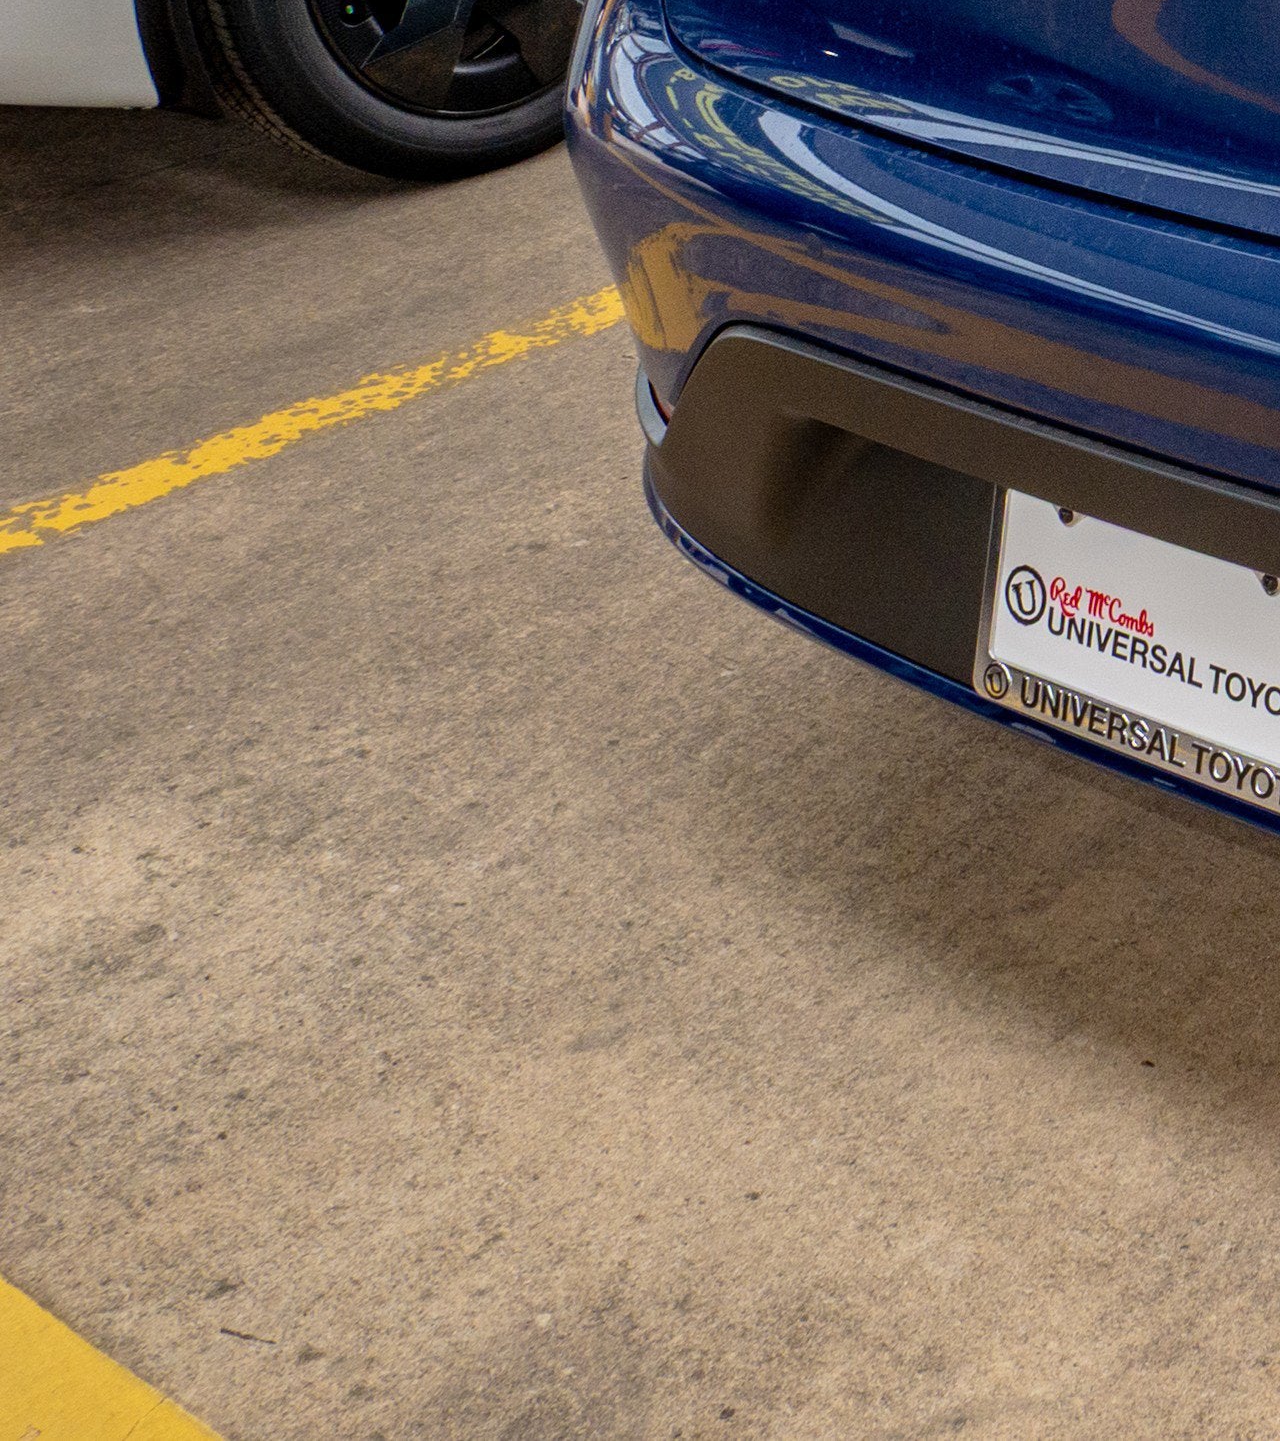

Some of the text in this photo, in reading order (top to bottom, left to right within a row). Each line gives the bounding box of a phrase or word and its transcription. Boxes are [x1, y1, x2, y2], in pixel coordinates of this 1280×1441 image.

[1048, 606, 1203, 689] UNIVERSAL
[1050, 576, 1154, 638] Red McCombs
[1020, 675, 1187, 768] UNIVERSAL
